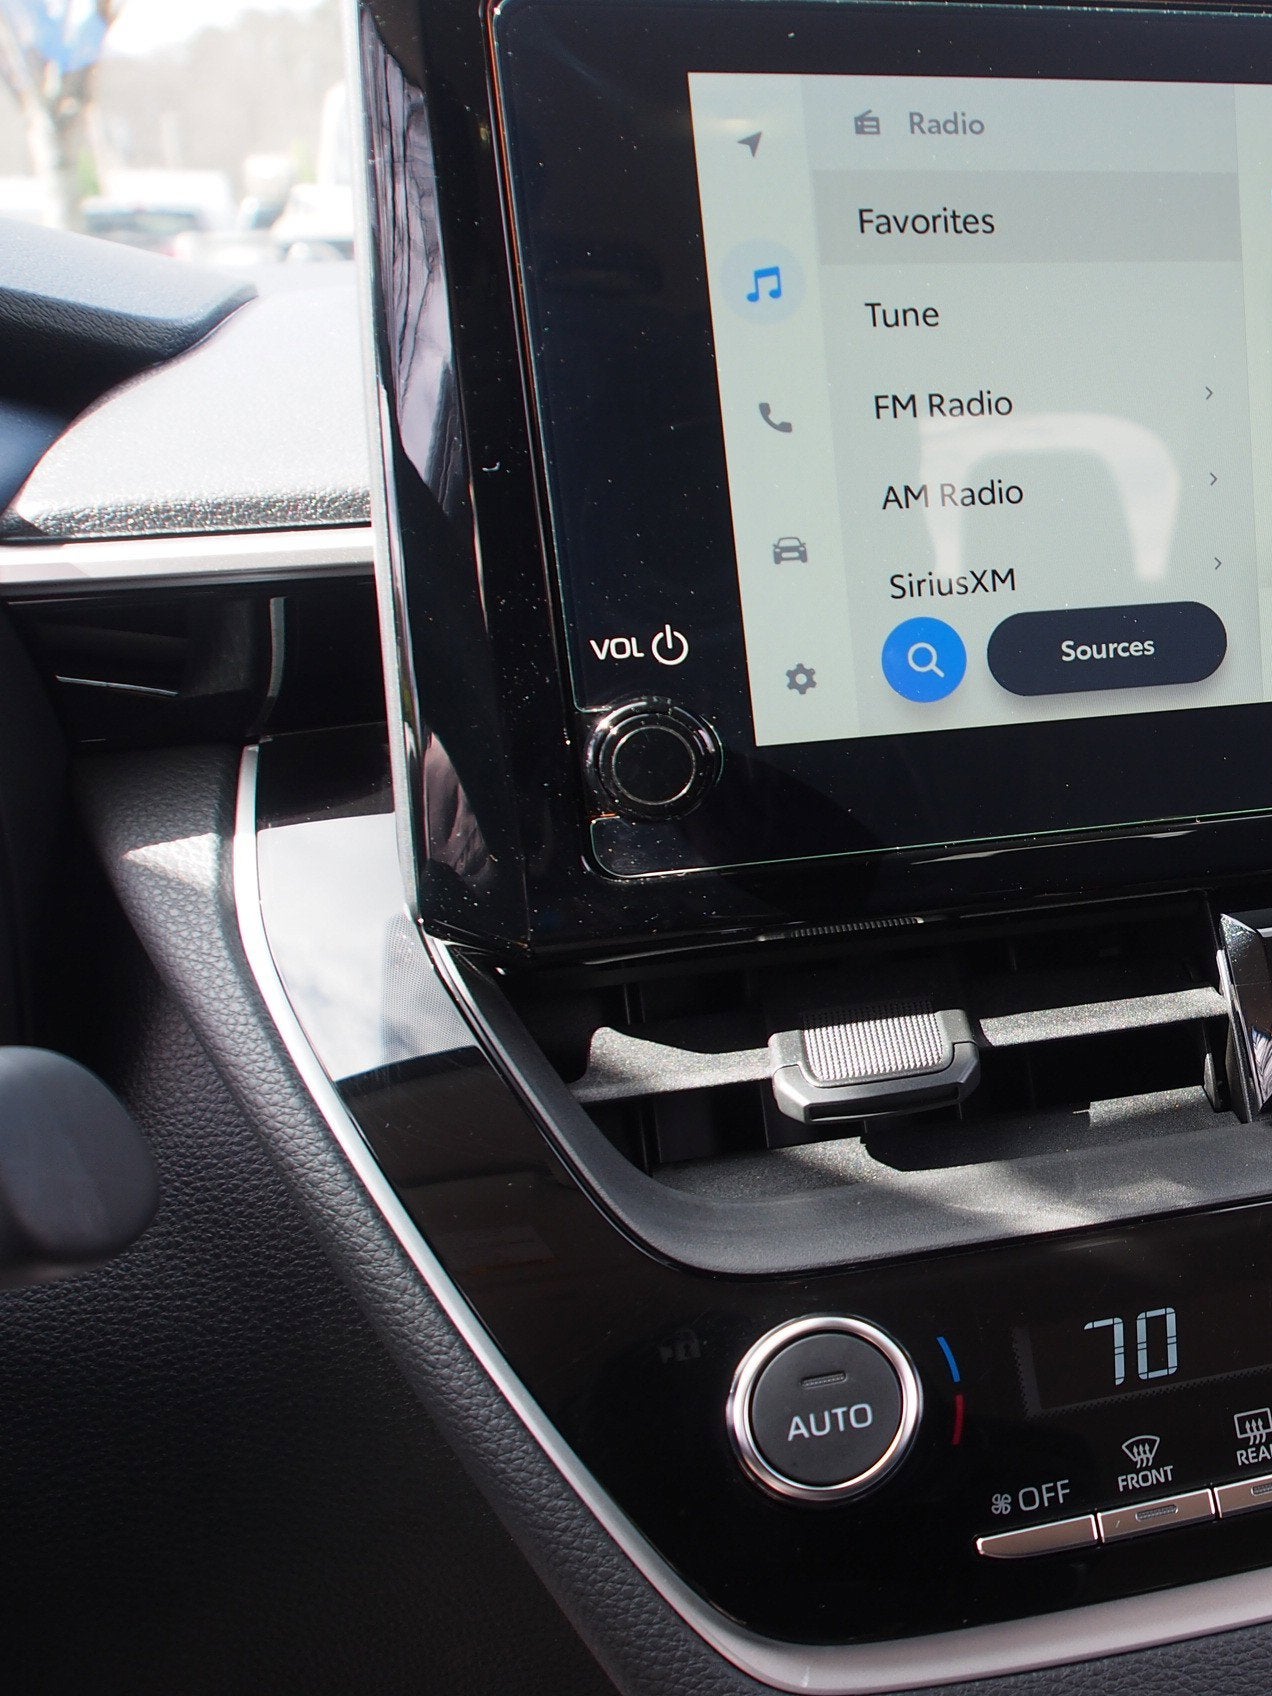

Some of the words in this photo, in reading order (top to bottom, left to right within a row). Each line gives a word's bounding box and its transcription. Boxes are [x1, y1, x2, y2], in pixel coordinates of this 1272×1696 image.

[908, 109, 986, 136] Radio
[857, 205, 996, 235] Favorites
[865, 301, 940, 328] Tune
[873, 391, 917, 419] FM
[928, 390, 1013, 417] Radio
[881, 484, 929, 510] AM
[940, 479, 1024, 508] Radio
[889, 567, 1017, 600] SiriusXM
[589, 637, 645, 660] VOL
[1060, 639, 1155, 662] Sources
[1083, 1306, 1179, 1386] 70
[786, 1402, 874, 1442] AUTO
[1117, 1465, 1175, 1492] FRONT
[1018, 1479, 1072, 1512] OFF
